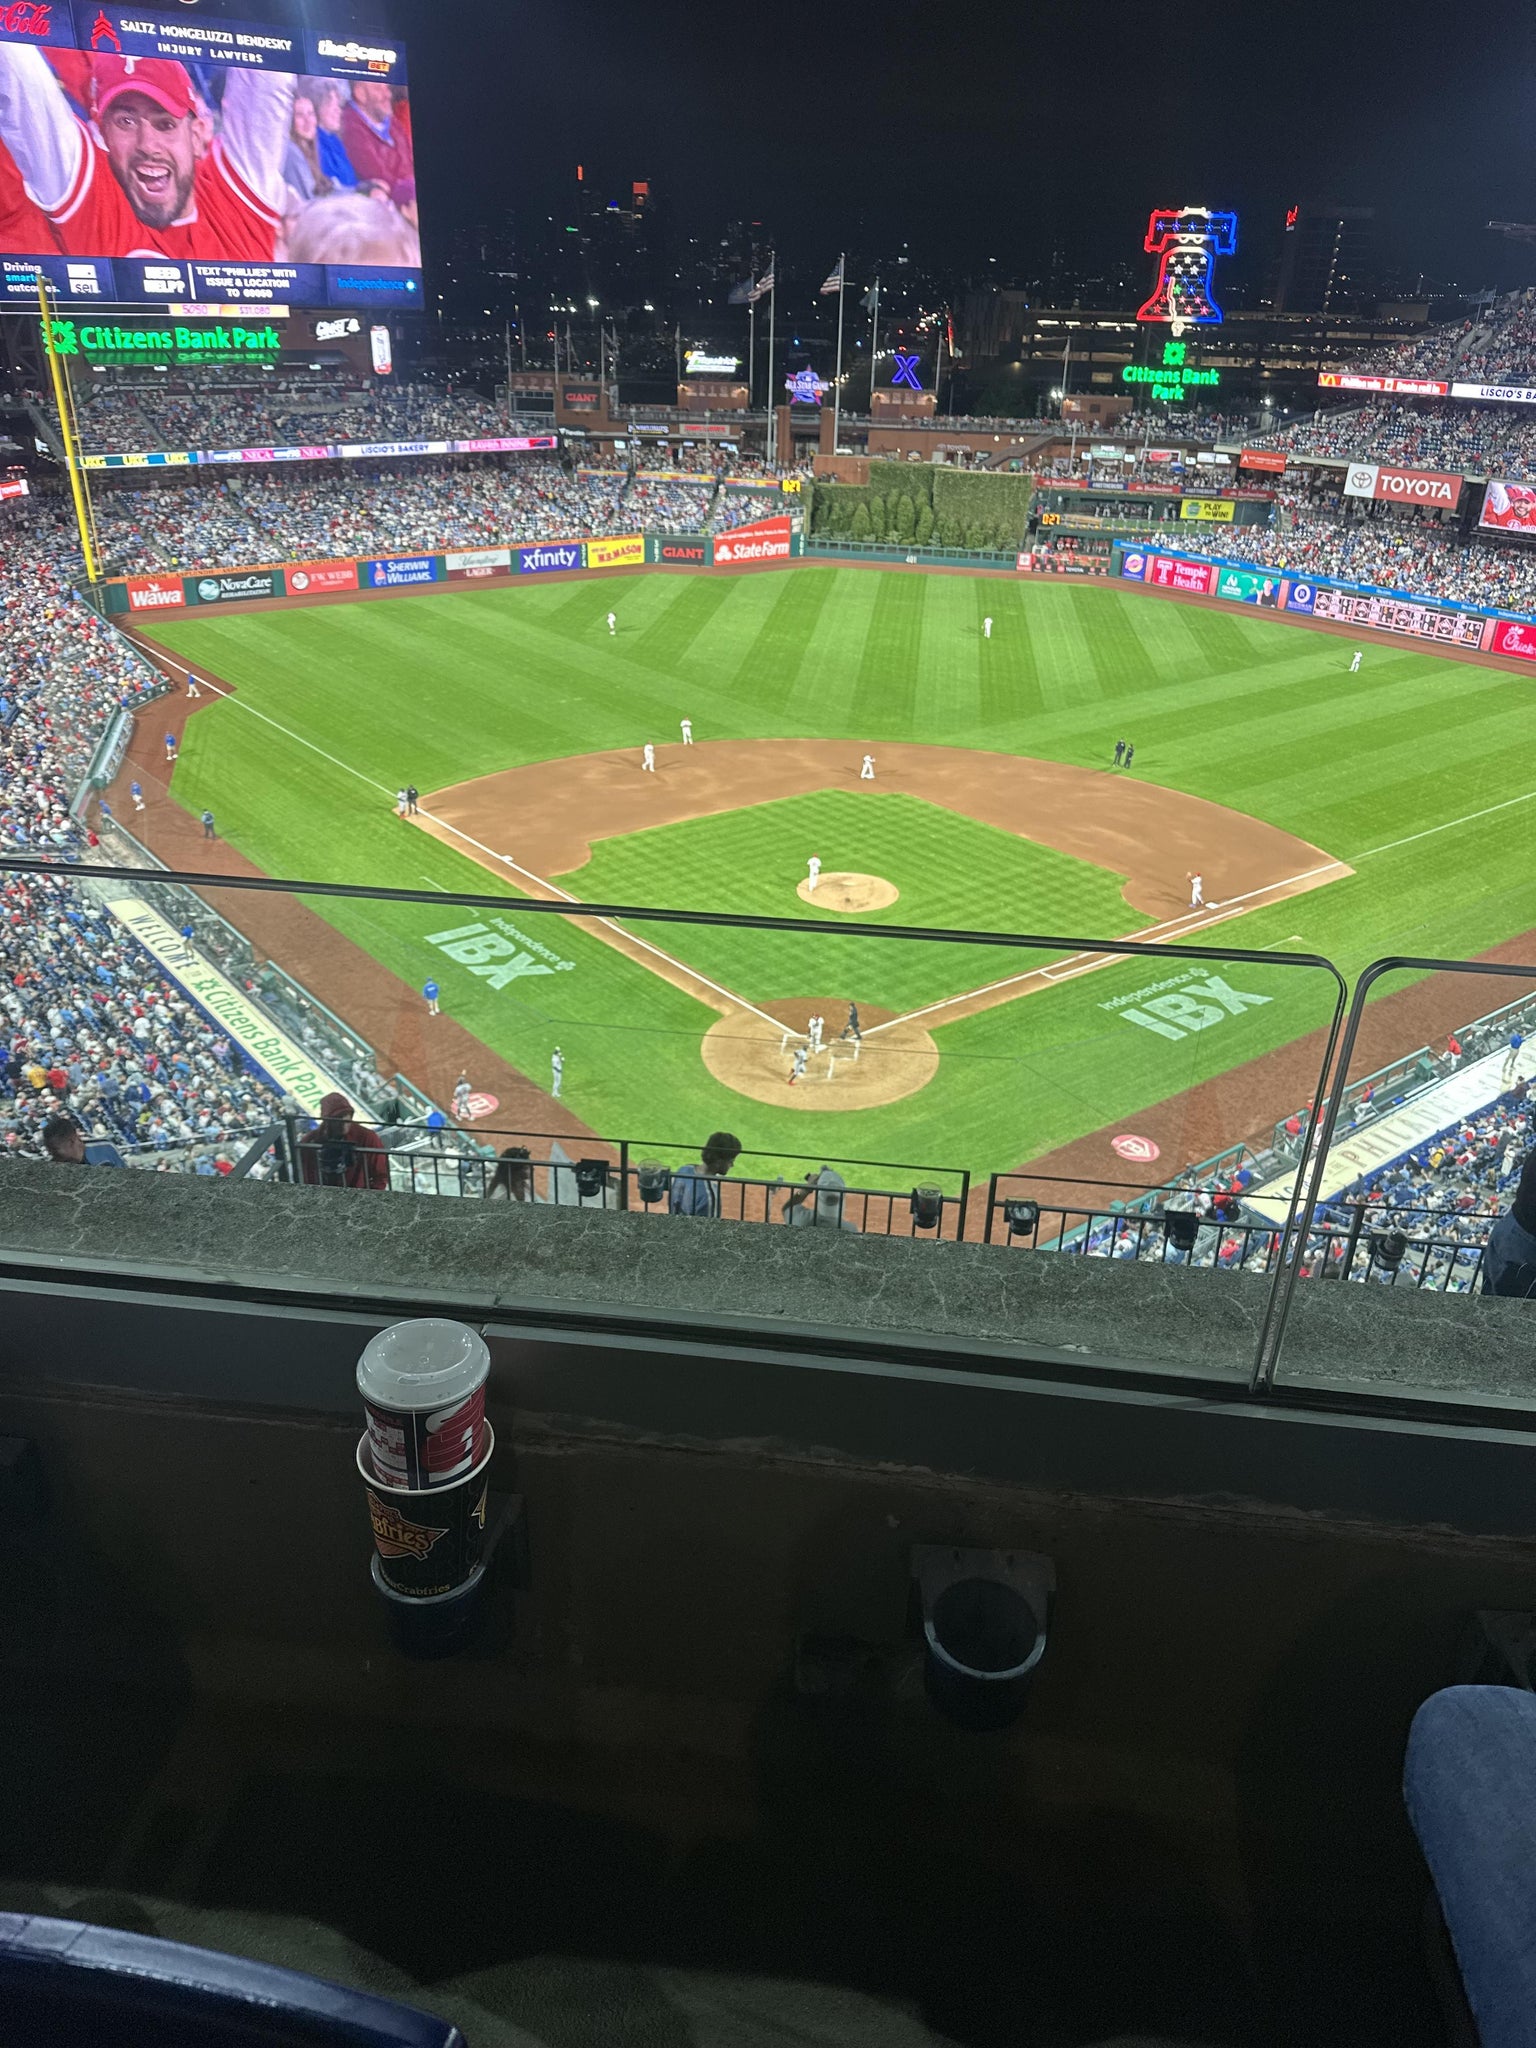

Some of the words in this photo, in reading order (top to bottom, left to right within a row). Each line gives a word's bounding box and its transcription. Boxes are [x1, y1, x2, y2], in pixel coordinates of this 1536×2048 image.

[120, 20, 156, 34] SALTZ
[160, 25, 233, 44] MONGELUZZI
[236, 34, 292, 51] BENDESKY
[157, 43, 202, 56] INJURY
[210, 49, 264, 63] LAWYERS
[369, 62, 388, 71] BET
[3, 262, 42, 274] Driving
[195, 266, 221, 276] TEXT
[272, 269, 297, 279] WITH
[206, 277, 236, 287] ISSUE
[236, 279, 243, 287] &
[243, 278, 290, 288] LOCATION
[337, 277, 405, 290] Independence
[226, 288, 240, 297] TO
[80, 326, 173, 349] Citizens
[174, 326, 231, 349] Bank
[232, 326, 280, 349] Park
[1122, 366, 1180, 383] Citizens
[1182, 368, 1219, 385] Bank
[565, 393, 597, 402] GIANT
[1152, 384, 1184, 400] Park
[1481, 388, 1522, 400] LISCIO'S
[300, 447, 328, 459] NECA
[361, 444, 396, 454] LISCIO'S
[398, 442, 430, 453] BAKERY
[79, 456, 107, 468] UKG
[122, 454, 149, 466] UKG
[164, 453, 190, 464] UKG
[243, 450, 273, 461] NECA
[1052, 478, 1080, 487] Budweiser
[1144, 483, 1173, 492] Budweiser
[1380, 474, 1452, 499] TOYOTA
[1204, 503, 1222, 511] PLAY
[1042, 513, 1061, 525] 027
[1211, 510, 1229, 518] WIN!
[522, 547, 577, 571] xfinity
[662, 546, 704, 559] GIANT
[387, 560, 429, 572] SHERWIN
[466, 568, 493, 577] LAGER
[1174, 563, 1208, 579] Temple
[220, 576, 272, 592] NovaCare
[1173, 576, 1204, 591] Health
[131, 589, 183, 606] Wawa
[128, 914, 199, 970] WELCOME
[489, 916, 560, 963] Independence
[423, 923, 555, 989] IBX
[1097, 970, 1192, 1011] Independence
[1119, 975, 1273, 1041] IBX
[205, 990, 264, 1040] Citizens
[252, 1037, 305, 1075] Bank
